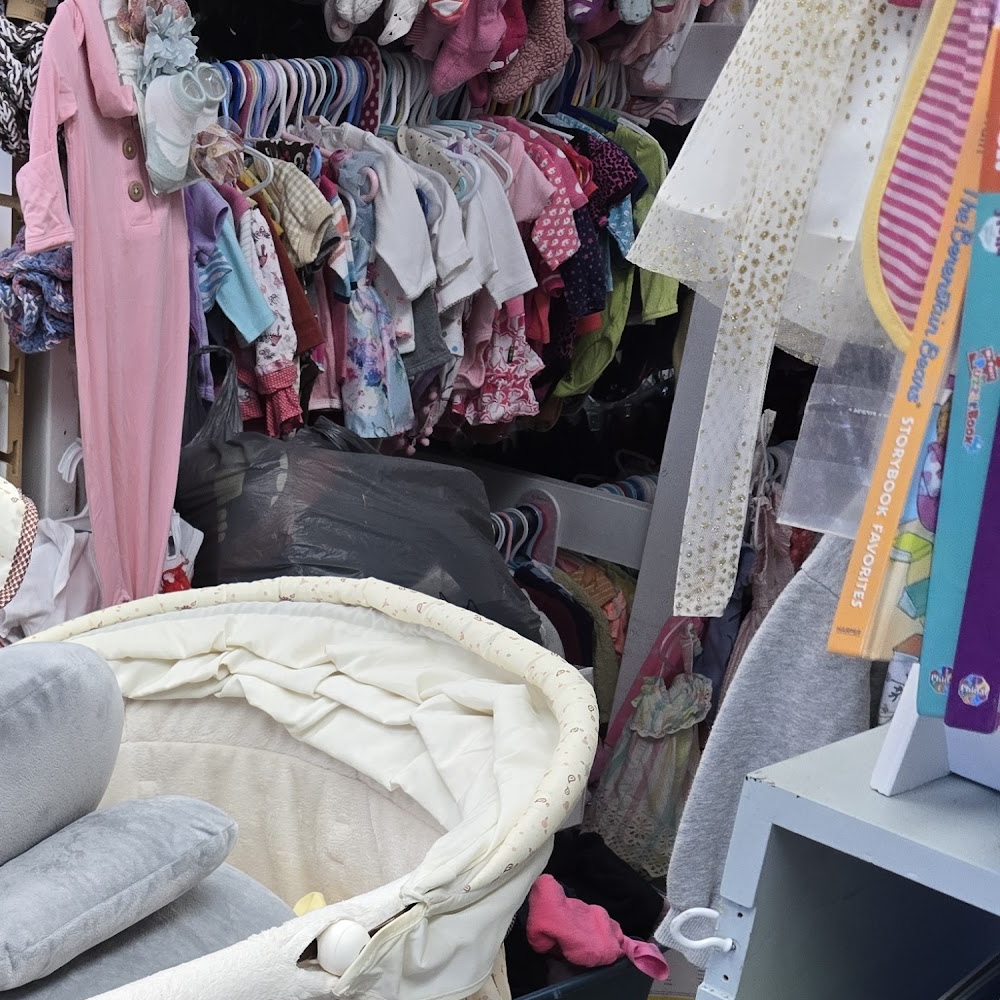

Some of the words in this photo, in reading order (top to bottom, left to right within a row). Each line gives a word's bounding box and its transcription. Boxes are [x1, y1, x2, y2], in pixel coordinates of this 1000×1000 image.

[907, 339, 939, 403] Bears
[876, 416, 914, 517] STORYBOOK
[851, 523, 883, 609] FAVORITES
